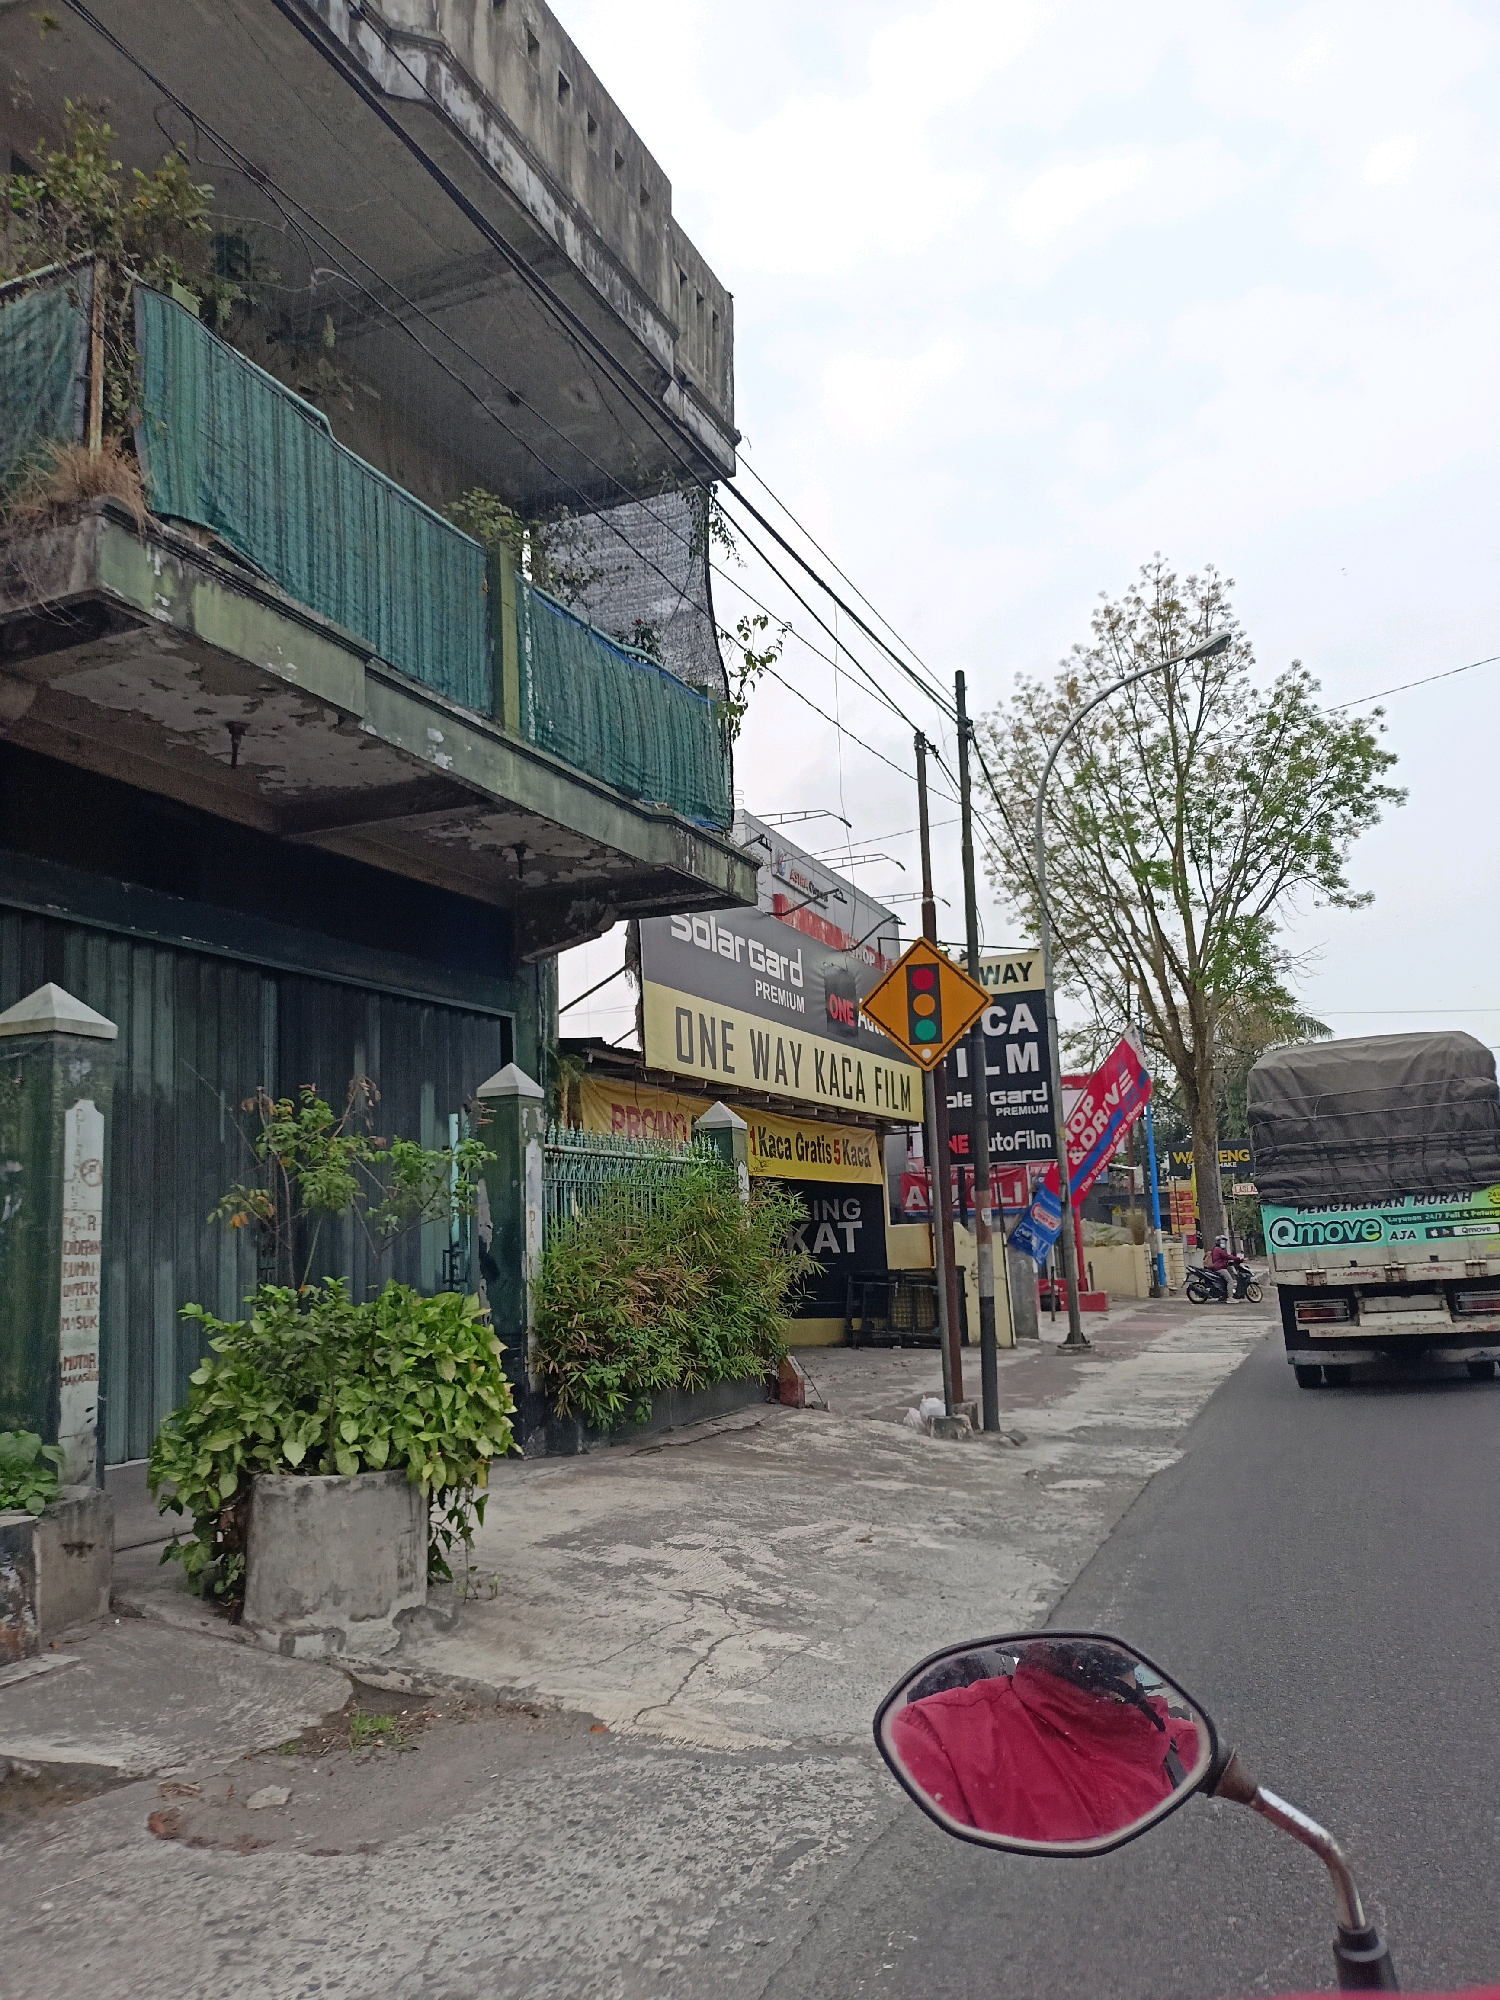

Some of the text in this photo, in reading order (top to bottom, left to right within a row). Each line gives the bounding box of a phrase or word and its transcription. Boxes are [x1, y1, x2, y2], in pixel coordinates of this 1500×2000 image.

[748, 938, 805, 988] Gard
[980, 961, 1033, 986] WAY
[754, 978, 806, 1014] PREMIUM
[828, 993, 856, 1027] ONE
[675, 1006, 912, 1113] ONE WAY KACA FILM
[989, 1081, 1049, 1106] Gard
[996, 1104, 1049, 1117] PREMIUM
[757, 1124, 792, 1161] Kaca
[795, 1131, 832, 1165] Gratis
[833, 1138, 841, 1165] 5
[842, 1138, 872, 1168] Kaca
[987, 1129, 1052, 1153] utoFilm
[1412, 1190, 1473, 1207] MURAH
[1270, 1217, 1382, 1247] Qmove
[1389, 1230, 1417, 1241] AJA
[1461, 1226, 1491, 1234] Qmove
